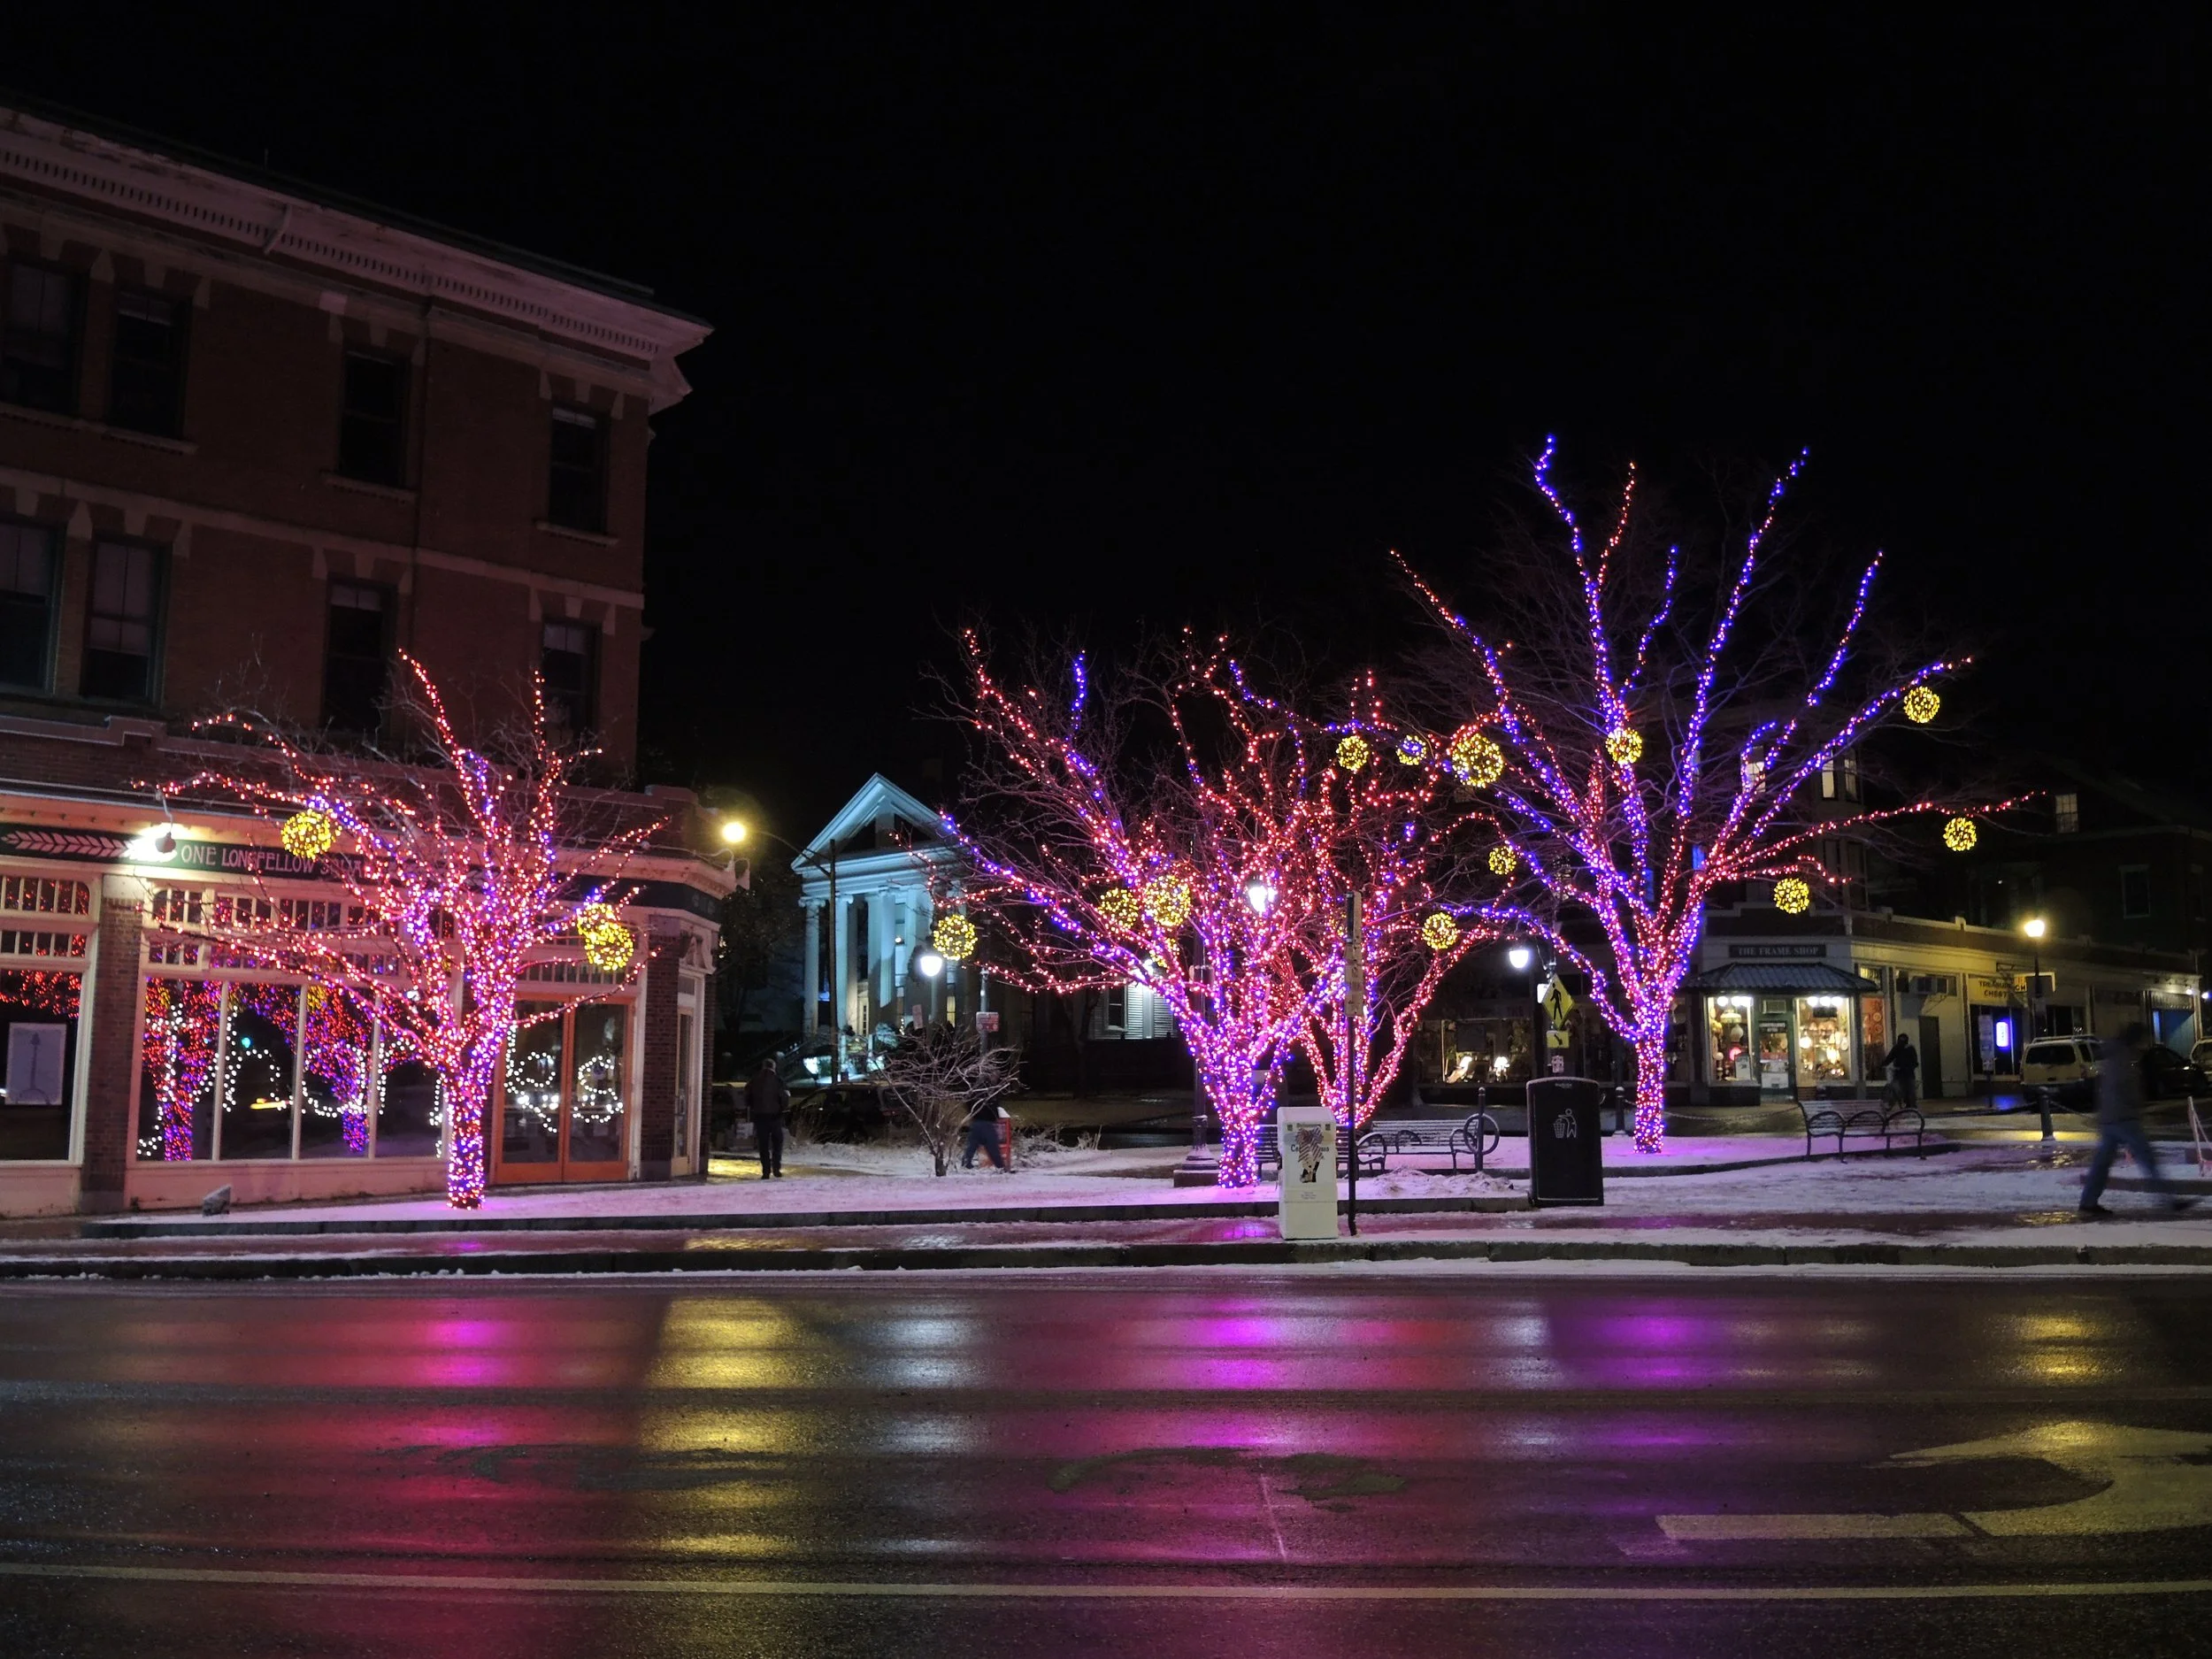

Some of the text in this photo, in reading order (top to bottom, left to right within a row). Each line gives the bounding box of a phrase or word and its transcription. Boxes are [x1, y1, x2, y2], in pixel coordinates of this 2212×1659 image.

[180, 845, 217, 866] ONE
[221, 848, 315, 874] LONGFELLOW
[1738, 946, 1819, 956] THE FRAME SHOP
[1984, 989, 2007, 999] CHEST
